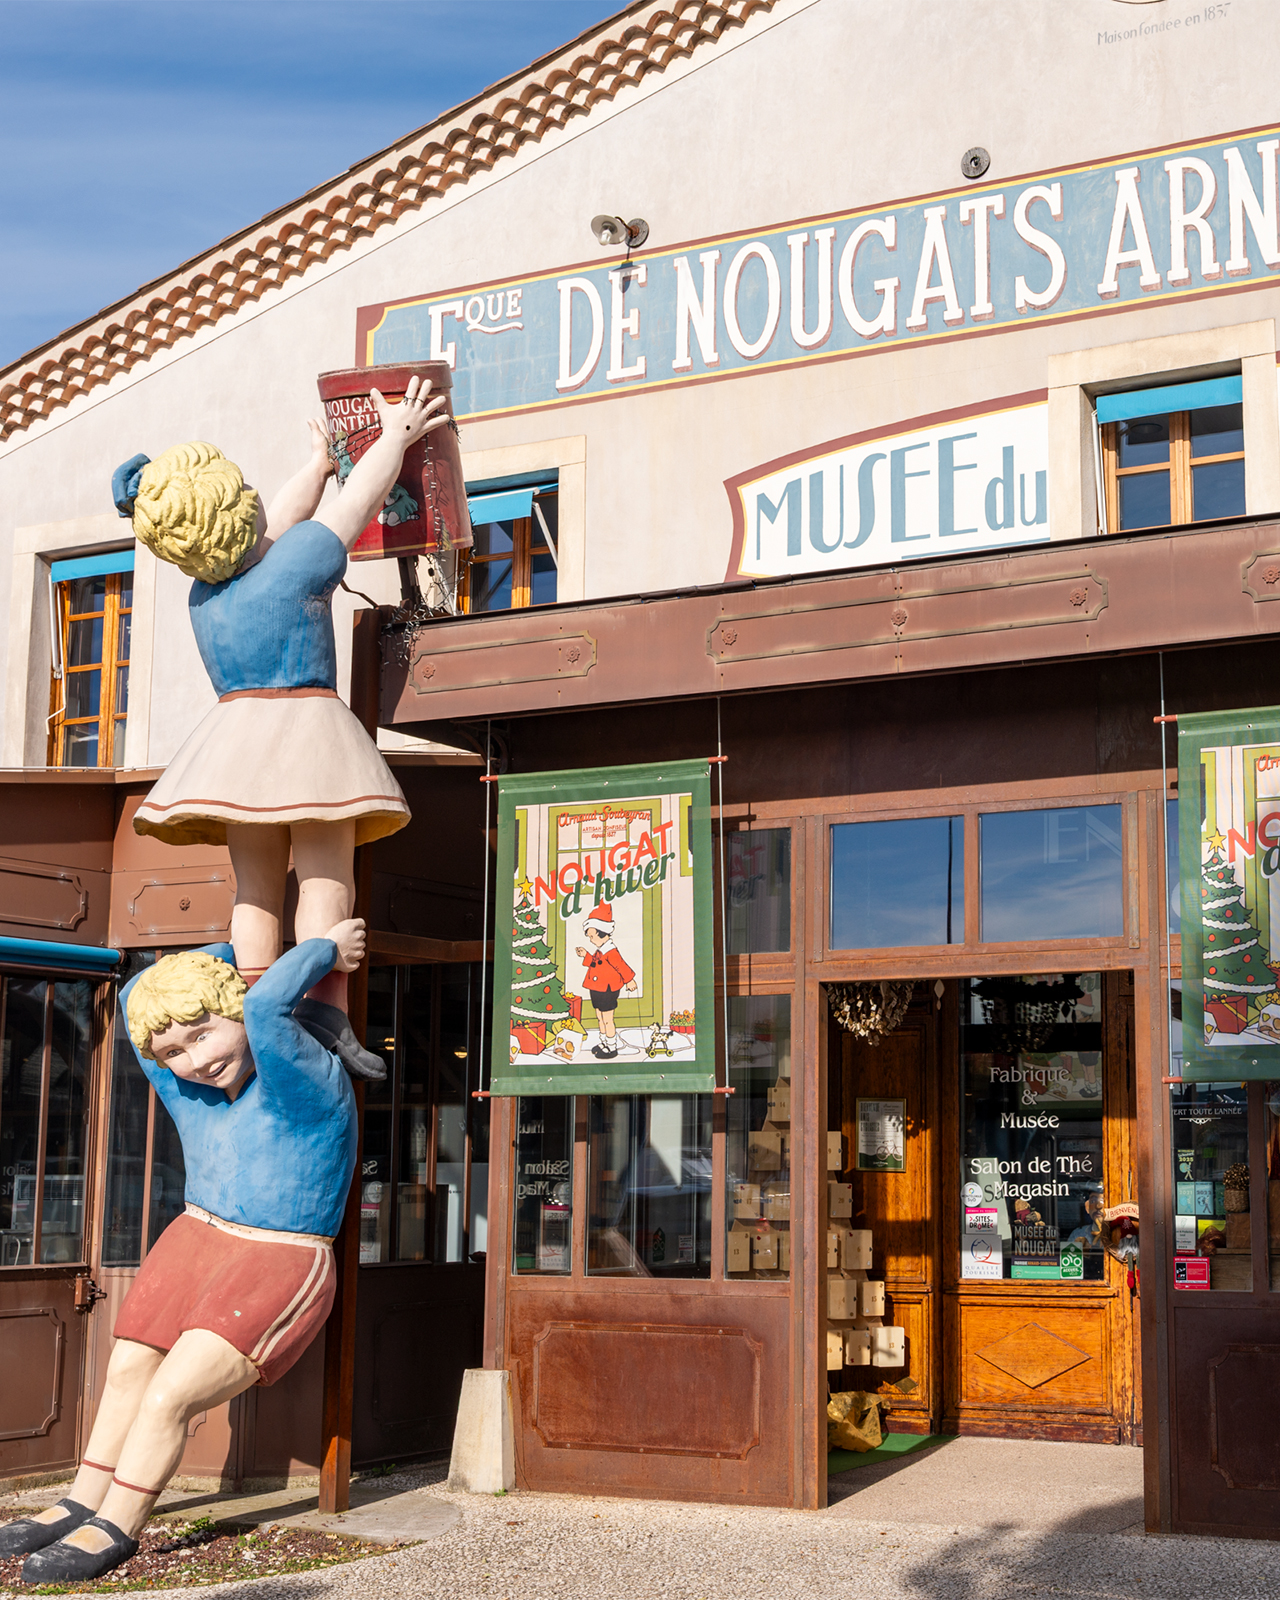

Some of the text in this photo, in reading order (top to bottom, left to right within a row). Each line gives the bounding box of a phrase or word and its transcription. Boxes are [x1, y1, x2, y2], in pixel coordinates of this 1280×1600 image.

[1097, 30, 1138, 46] Maison
[1139, 17, 1182, 37] fondée
[1185, 13, 1201, 27] en
[555, 263, 648, 394] DE
[671, 182, 1068, 373] NOUGATS
[1097, 140, 1280, 298] ARN
[755, 432, 1047, 561] MUSEE du
[598, 805, 651, 824] Soubeyran
[534, 820, 674, 907] NOUGAT
[560, 852, 676, 919] d'hiver
[990, 1066, 1071, 1087] Fabrique
[1021, 1091, 1038, 1106] &
[1000, 1110, 1060, 1129] Musée
[1188, 1108, 1213, 1116] TOUTE
[970, 1155, 1093, 1175] Salon de Thé
[993, 1180, 1070, 1201] Magasin
[1045, 1226, 1057, 1239] du
[1014, 1240, 1057, 1256] NOUGAT
